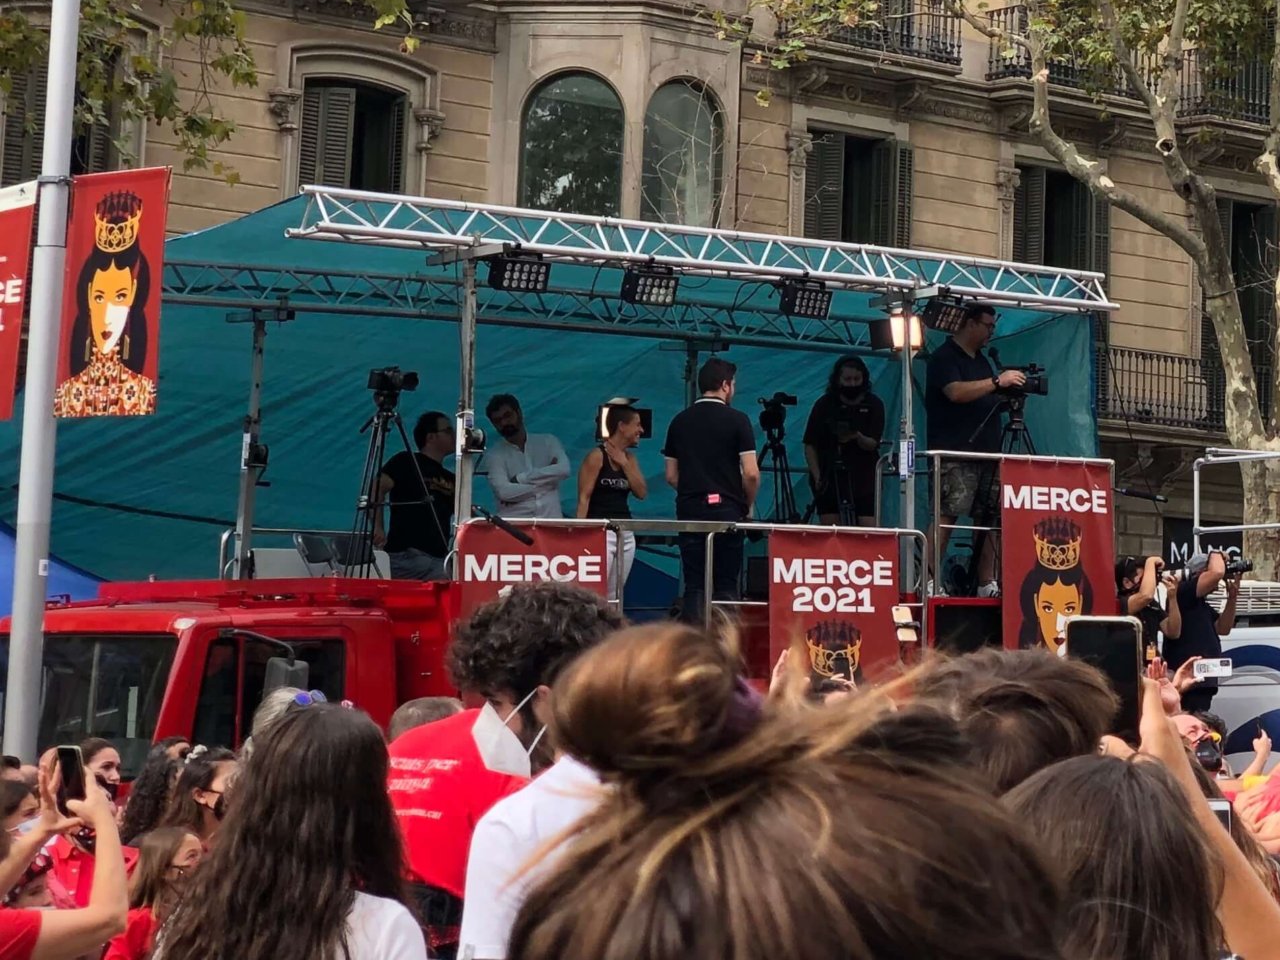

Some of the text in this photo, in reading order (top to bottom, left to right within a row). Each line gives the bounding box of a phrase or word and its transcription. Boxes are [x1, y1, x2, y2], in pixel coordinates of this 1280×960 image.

[1003, 483, 1108, 514] MERCÈ
[464, 548, 602, 582] MERCÈ
[773, 554, 893, 585] MERCÈ
[792, 586, 875, 613] 2021
